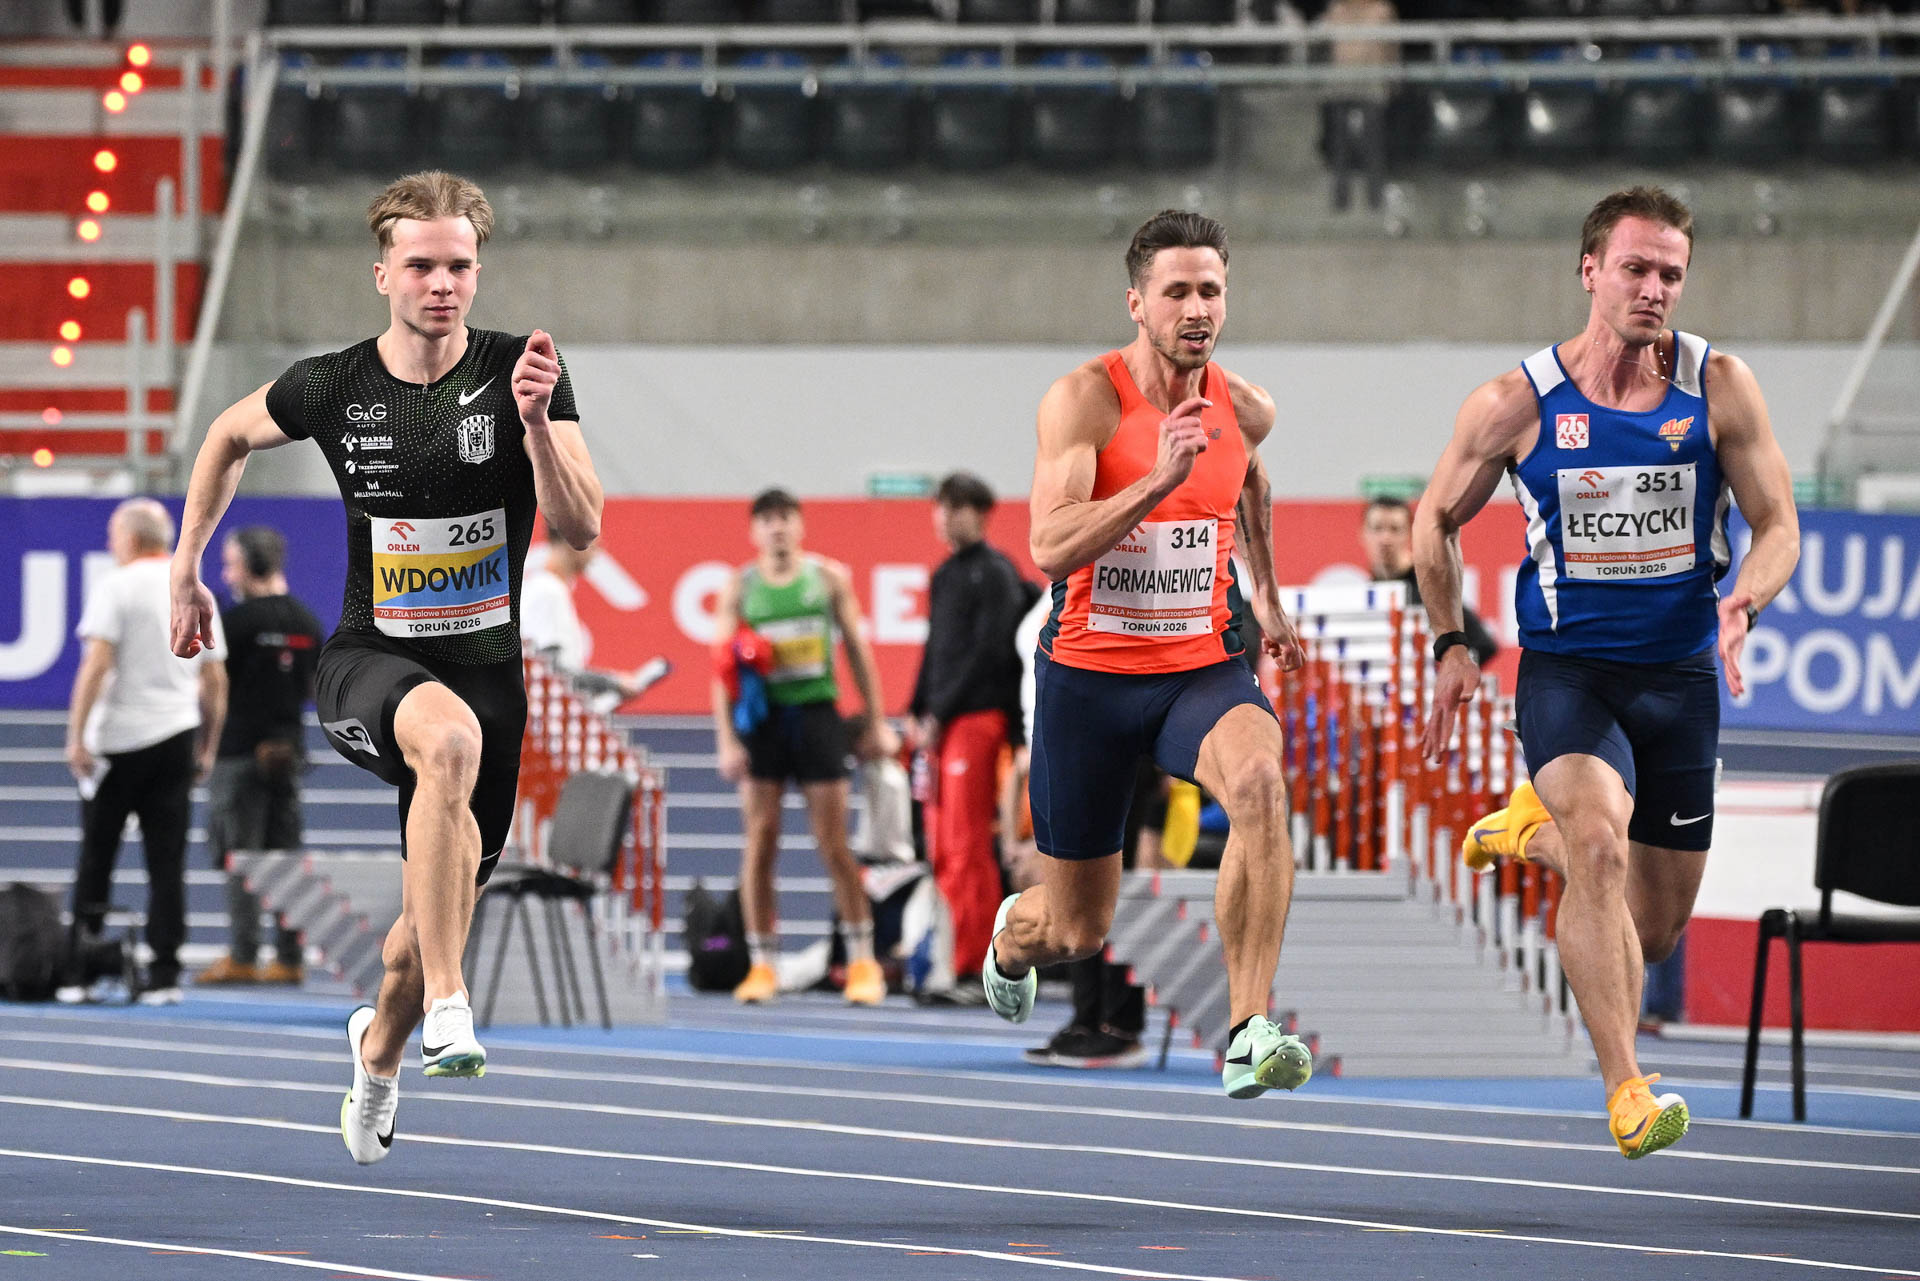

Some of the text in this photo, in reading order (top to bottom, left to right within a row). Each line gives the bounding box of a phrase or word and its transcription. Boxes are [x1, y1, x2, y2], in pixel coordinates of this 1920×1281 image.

[347, 403, 388, 421] G&G
[360, 435, 393, 443] MARMA
[1636, 471, 1684, 493] 351
[1576, 491, 1609, 500] ORLEN
[448, 517, 495, 547] 265
[1567, 506, 1687, 543] ŁĘCZYCKI
[1171, 526, 1209, 549] 314
[387, 543, 420, 552] ORLEN
[1600, 552, 1627, 561] Halowe
[1628, 549, 1671, 561] Mistrzostwa
[380, 558, 502, 593] WDOWIK
[1596, 562, 1667, 575] TORUŃ 2026
[1097, 566, 1213, 594] FORMANIEWICZ
[380, 598, 505, 618] 70. PZLA Halowe Mistrzostwa Polski
[1095, 605, 1208, 618] 70. PZLA Halowe Mistrzostwa Polski
[408, 617, 481, 632] TORUŃ 2026
[1121, 621, 1187, 632] TORUŃ 2026
[334, 725, 370, 746] 5
